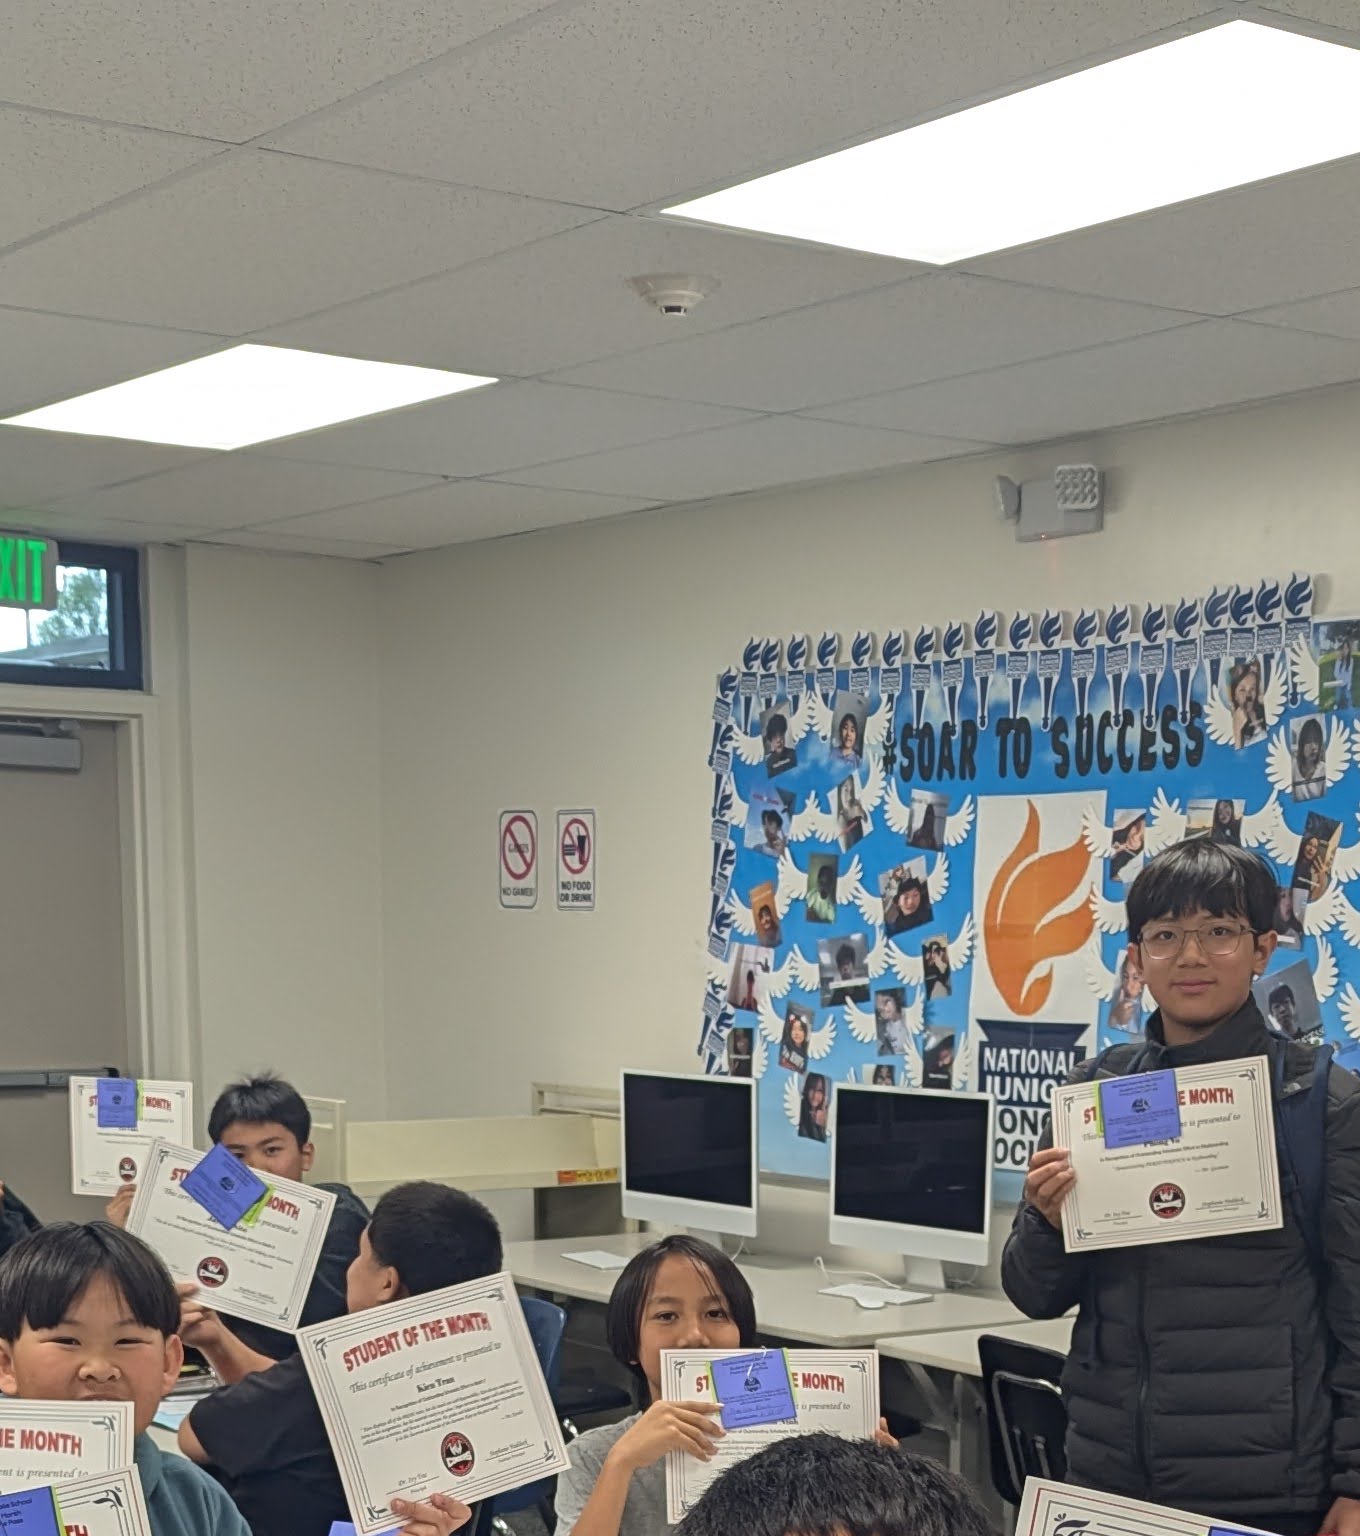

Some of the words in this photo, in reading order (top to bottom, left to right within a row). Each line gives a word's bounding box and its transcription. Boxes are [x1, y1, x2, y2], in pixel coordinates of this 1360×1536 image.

[996, 716, 1032, 779] TO
[1051, 702, 1204, 779] SUCCESS
[572, 881, 591, 890] FOOD
[986, 1075, 1060, 1103] UNIO
[1189, 1087, 1235, 1105] MONTH
[145, 1097, 172, 1111] MONTH
[343, 1331, 402, 1372] STUDENT
[402, 1326, 419, 1347] OF
[419, 1319, 447, 1342] THE
[445, 1312, 492, 1336] MONTH
[801, 1372, 845, 1393] MONTH
[20, 1429, 82, 1457] MONTH
[26, 1467, 76, 1480] presented
